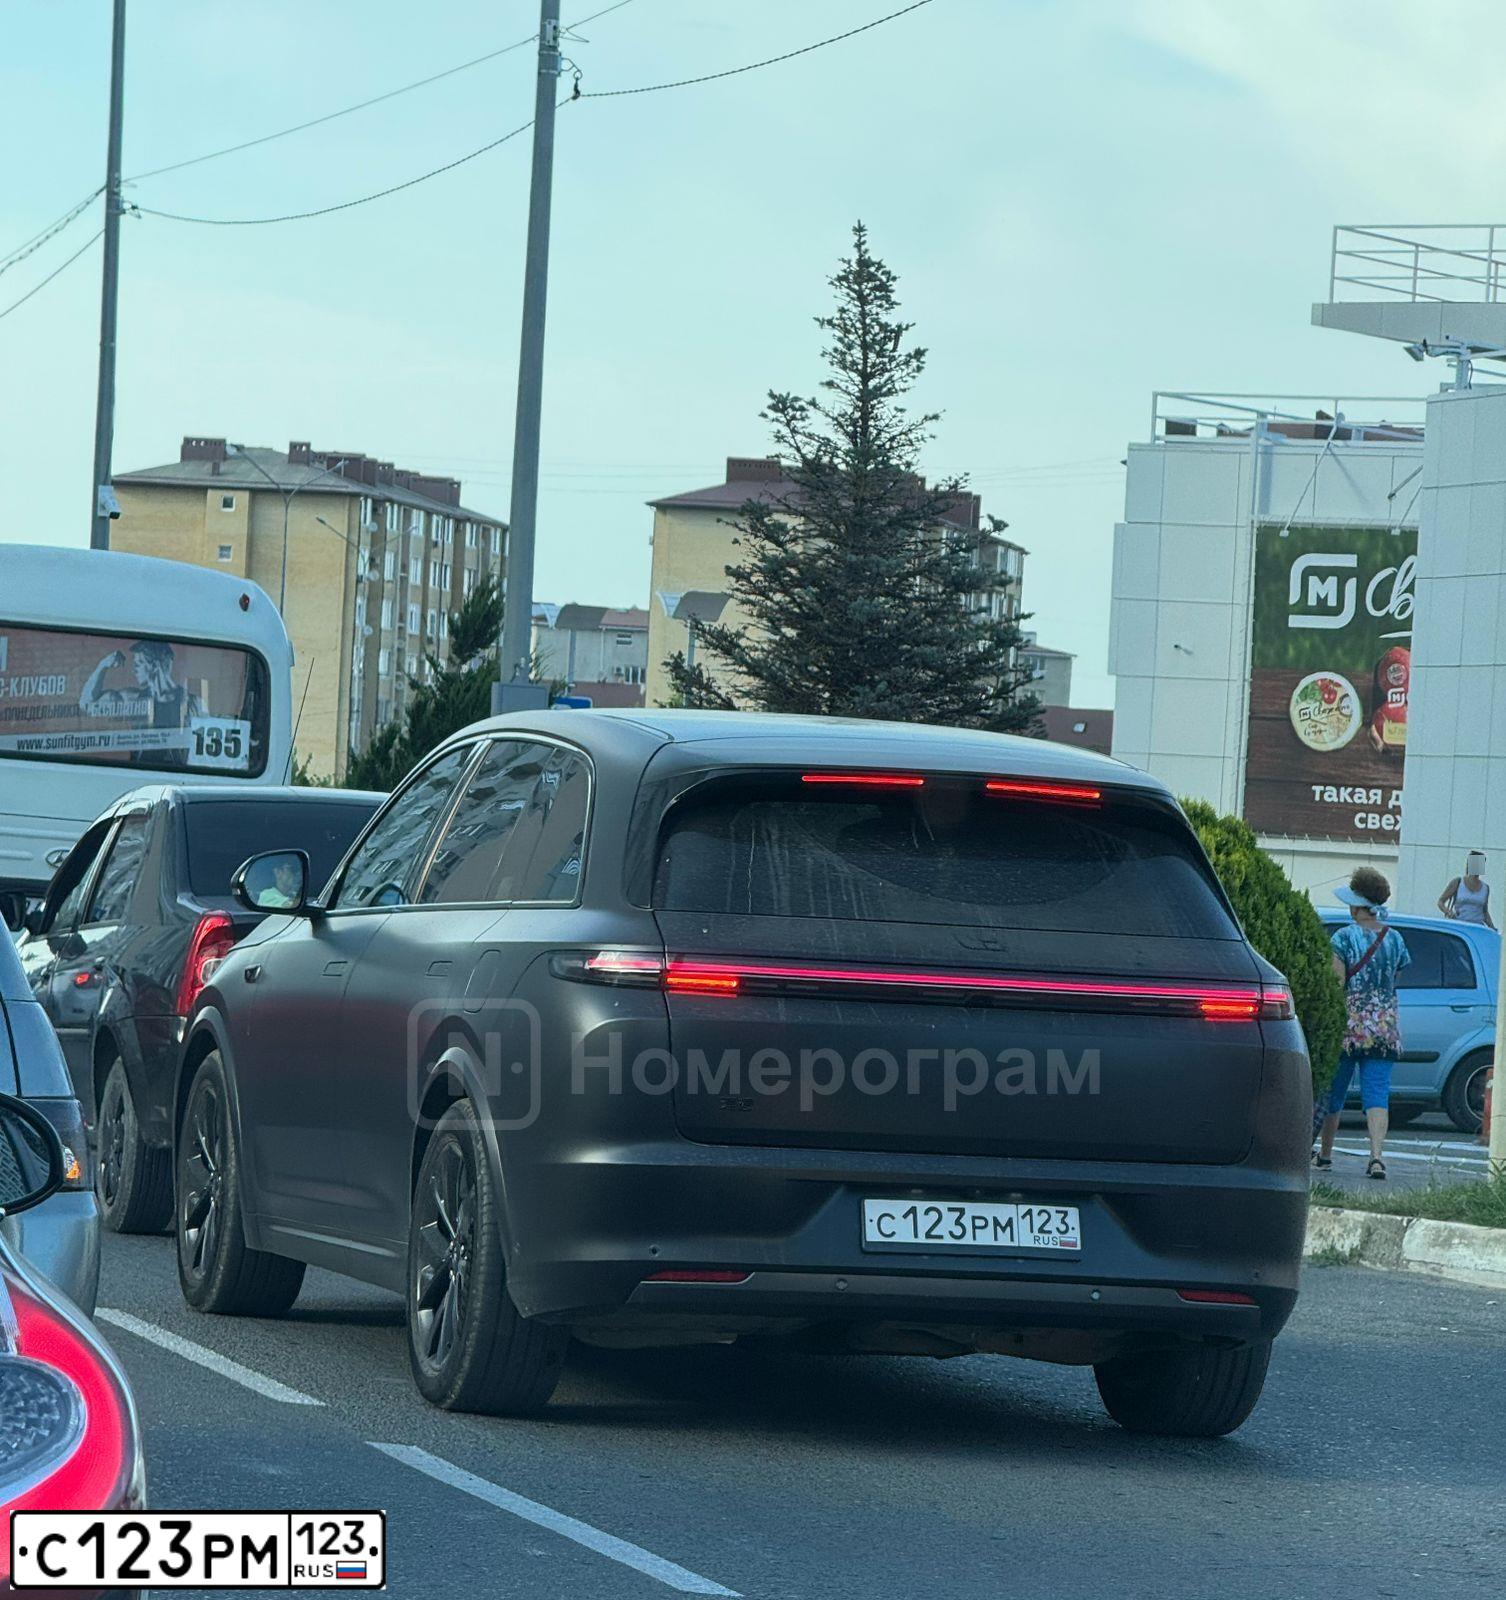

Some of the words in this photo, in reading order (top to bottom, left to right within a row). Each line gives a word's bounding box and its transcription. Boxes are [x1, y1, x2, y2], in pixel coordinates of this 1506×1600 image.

[17, 734, 110, 751] www.sunfitgym.ru
[192, 727, 242, 758] 135
[1312, 784, 1382, 805] такая
[1021, 1208, 1070, 1235] 123
[1033, 1235, 1059, 1247] RUS
